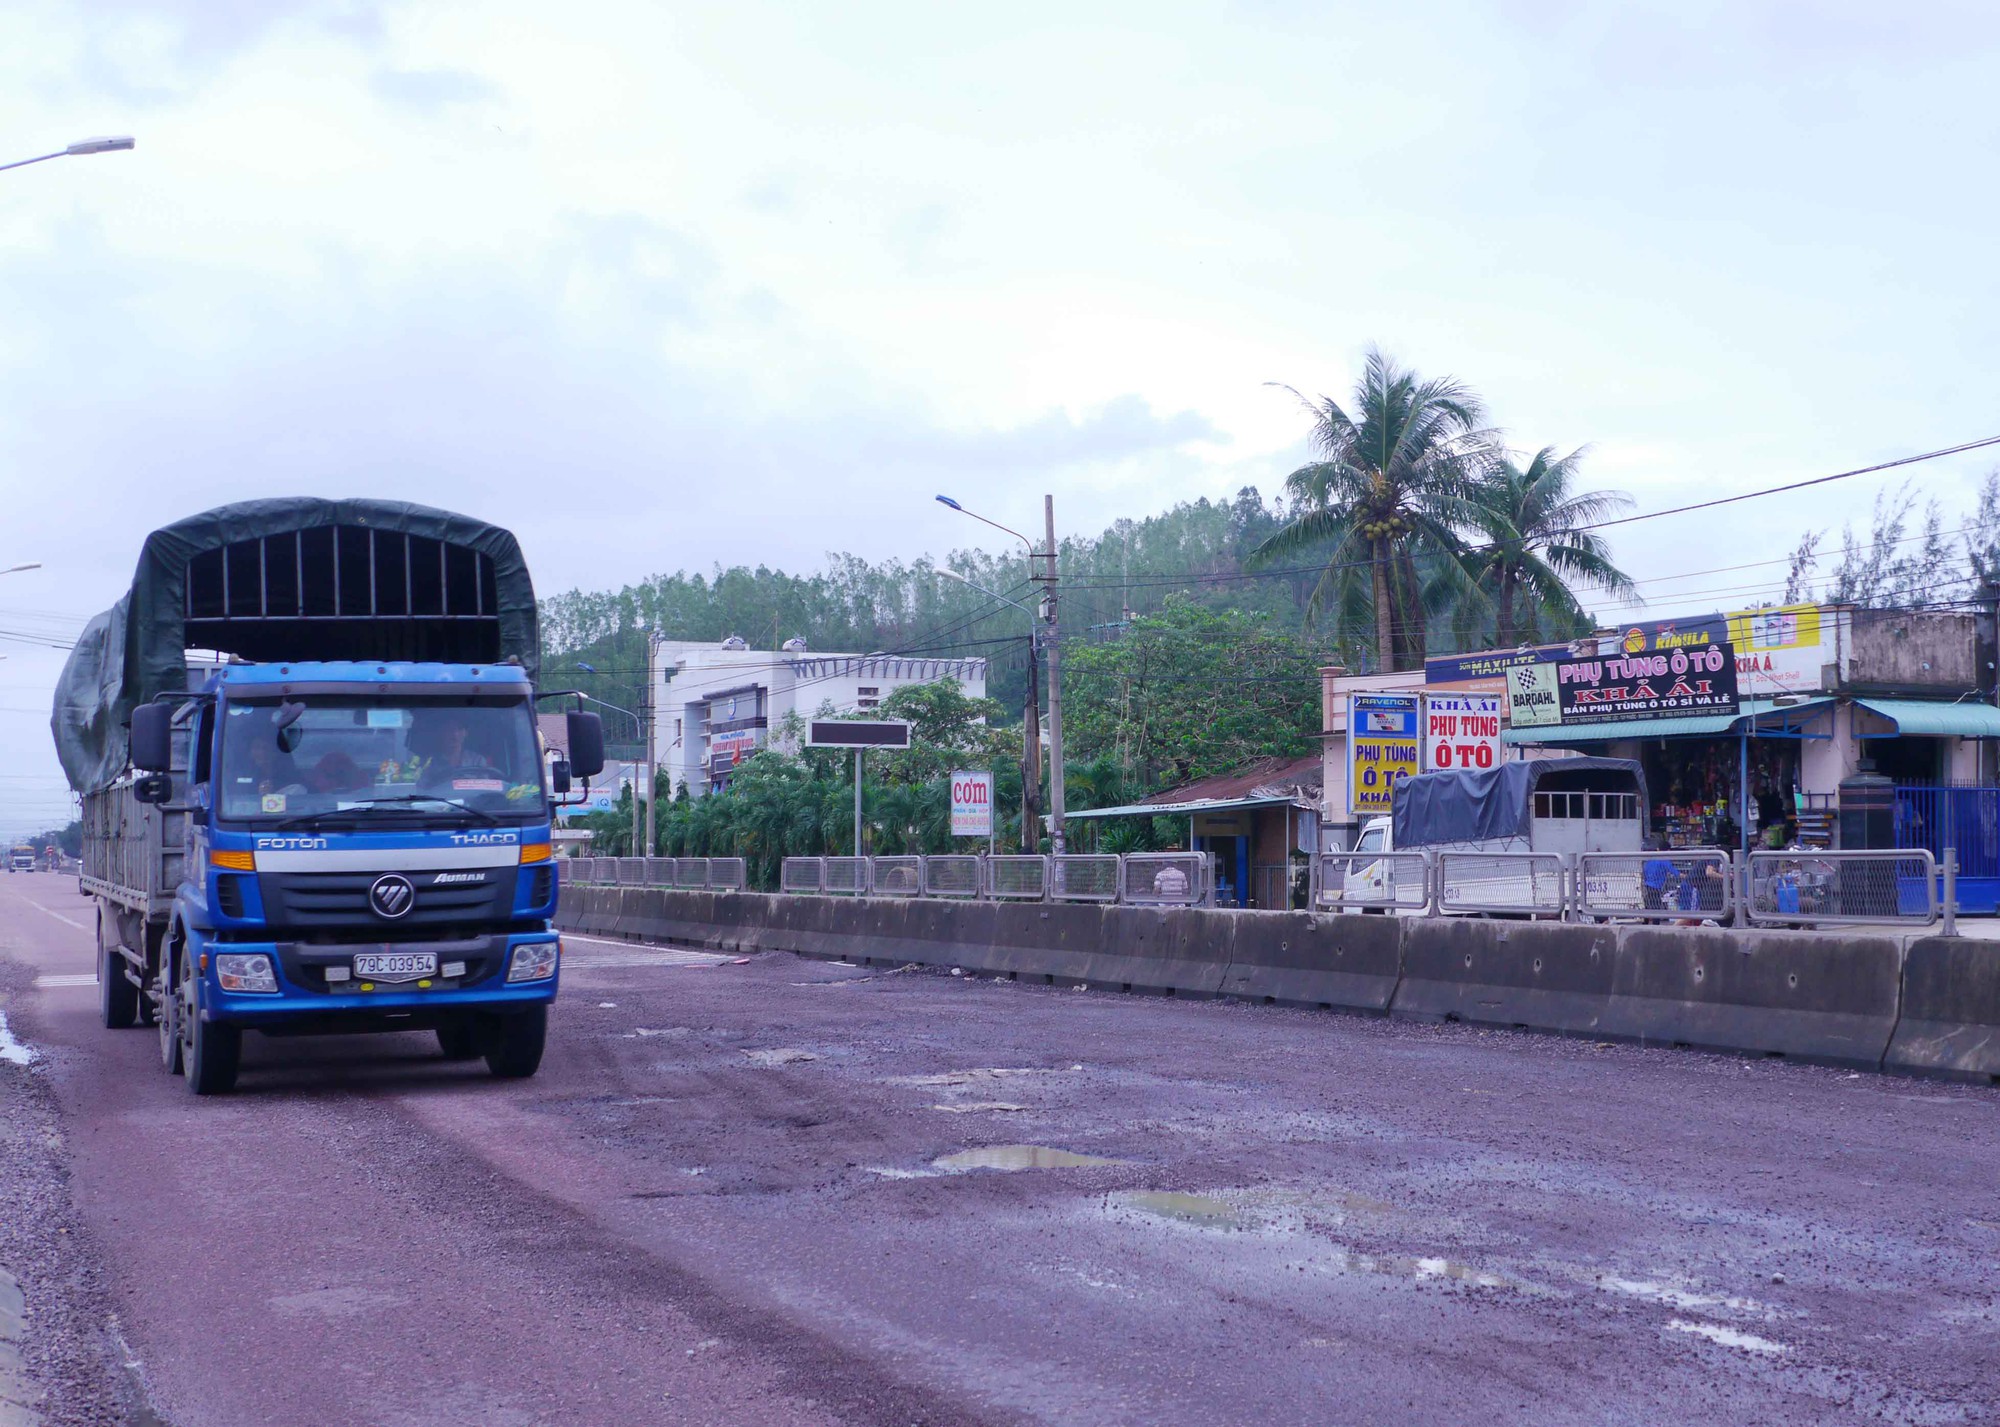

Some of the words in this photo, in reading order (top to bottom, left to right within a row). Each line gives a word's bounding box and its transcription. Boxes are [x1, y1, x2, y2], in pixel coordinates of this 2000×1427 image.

[1559, 661, 1602, 687] PHỤ
[1605, 653, 1668, 680] TÙNG
[1670, 648, 1688, 675] Ô
[1689, 645, 1724, 672] TÔ
[1513, 691, 1556, 707] BARDAHL
[1574, 679, 1659, 704] KHẢ
[1666, 675, 1713, 697] ÁI
[1477, 698, 1497, 711] ÁI
[1563, 705, 1587, 714] BÁN
[1589, 704, 1612, 713] PHỤ
[1615, 701, 1647, 710] TÙNG
[1649, 699, 1658, 708] Ô
[1660, 698, 1677, 707] TÔ
[1696, 695, 1712, 705] VÀ
[1430, 715, 1457, 740] PHỤ
[1461, 711, 1498, 737] TÙNG
[1356, 745, 1380, 766] PHỤ
[1435, 739, 1452, 768] Ô
[1456, 740, 1492, 768] TÔ
[1363, 766, 1377, 787] Ô
[258, 838, 327, 849] FOTON
[450, 833, 517, 844] THACO
[359, 957, 433, 972] 79C-039.54
